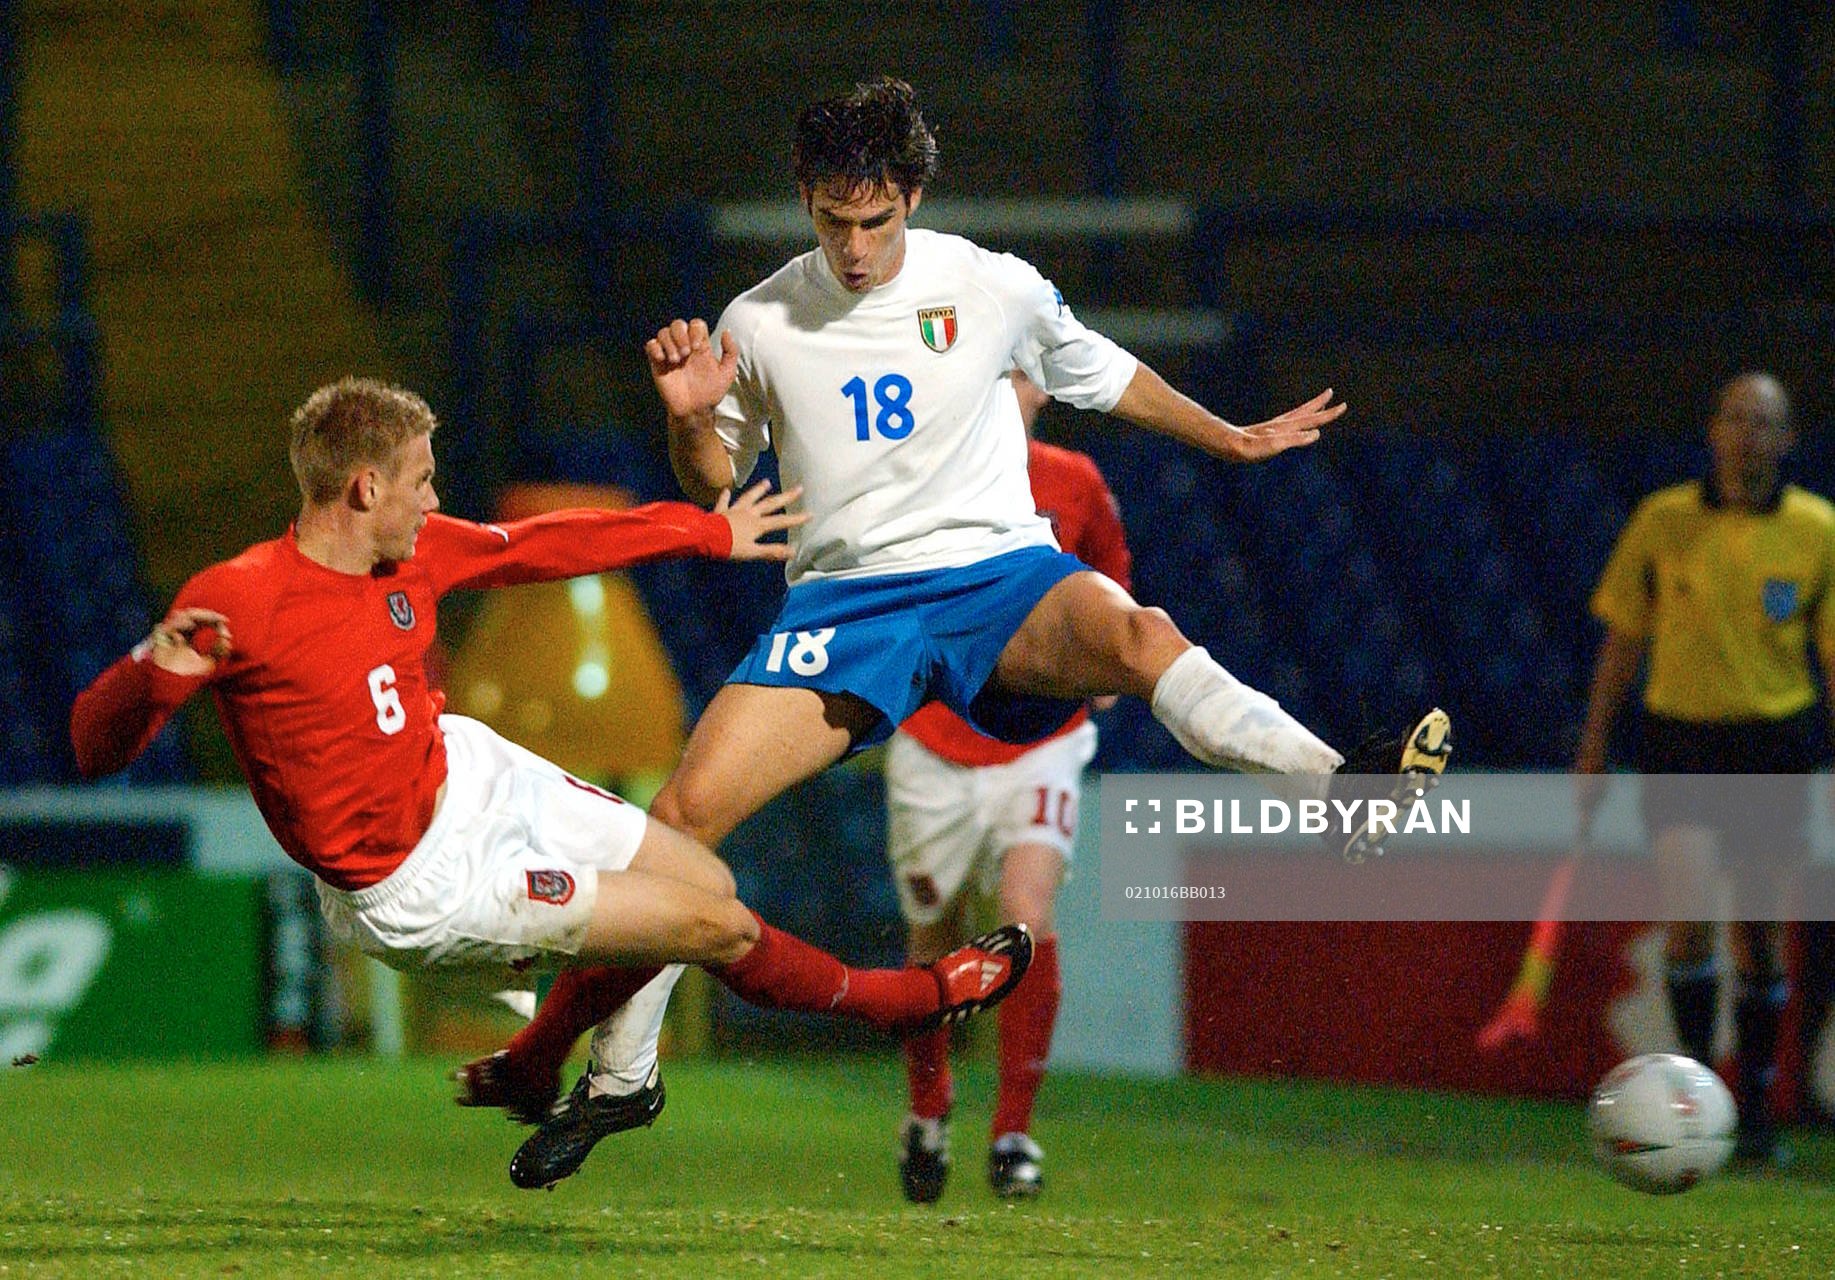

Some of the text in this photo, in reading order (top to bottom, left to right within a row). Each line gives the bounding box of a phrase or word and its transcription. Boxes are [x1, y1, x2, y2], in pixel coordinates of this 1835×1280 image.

[840, 373, 915, 442] 18
[765, 626, 837, 677] 18
[367, 663, 407, 736] 6
